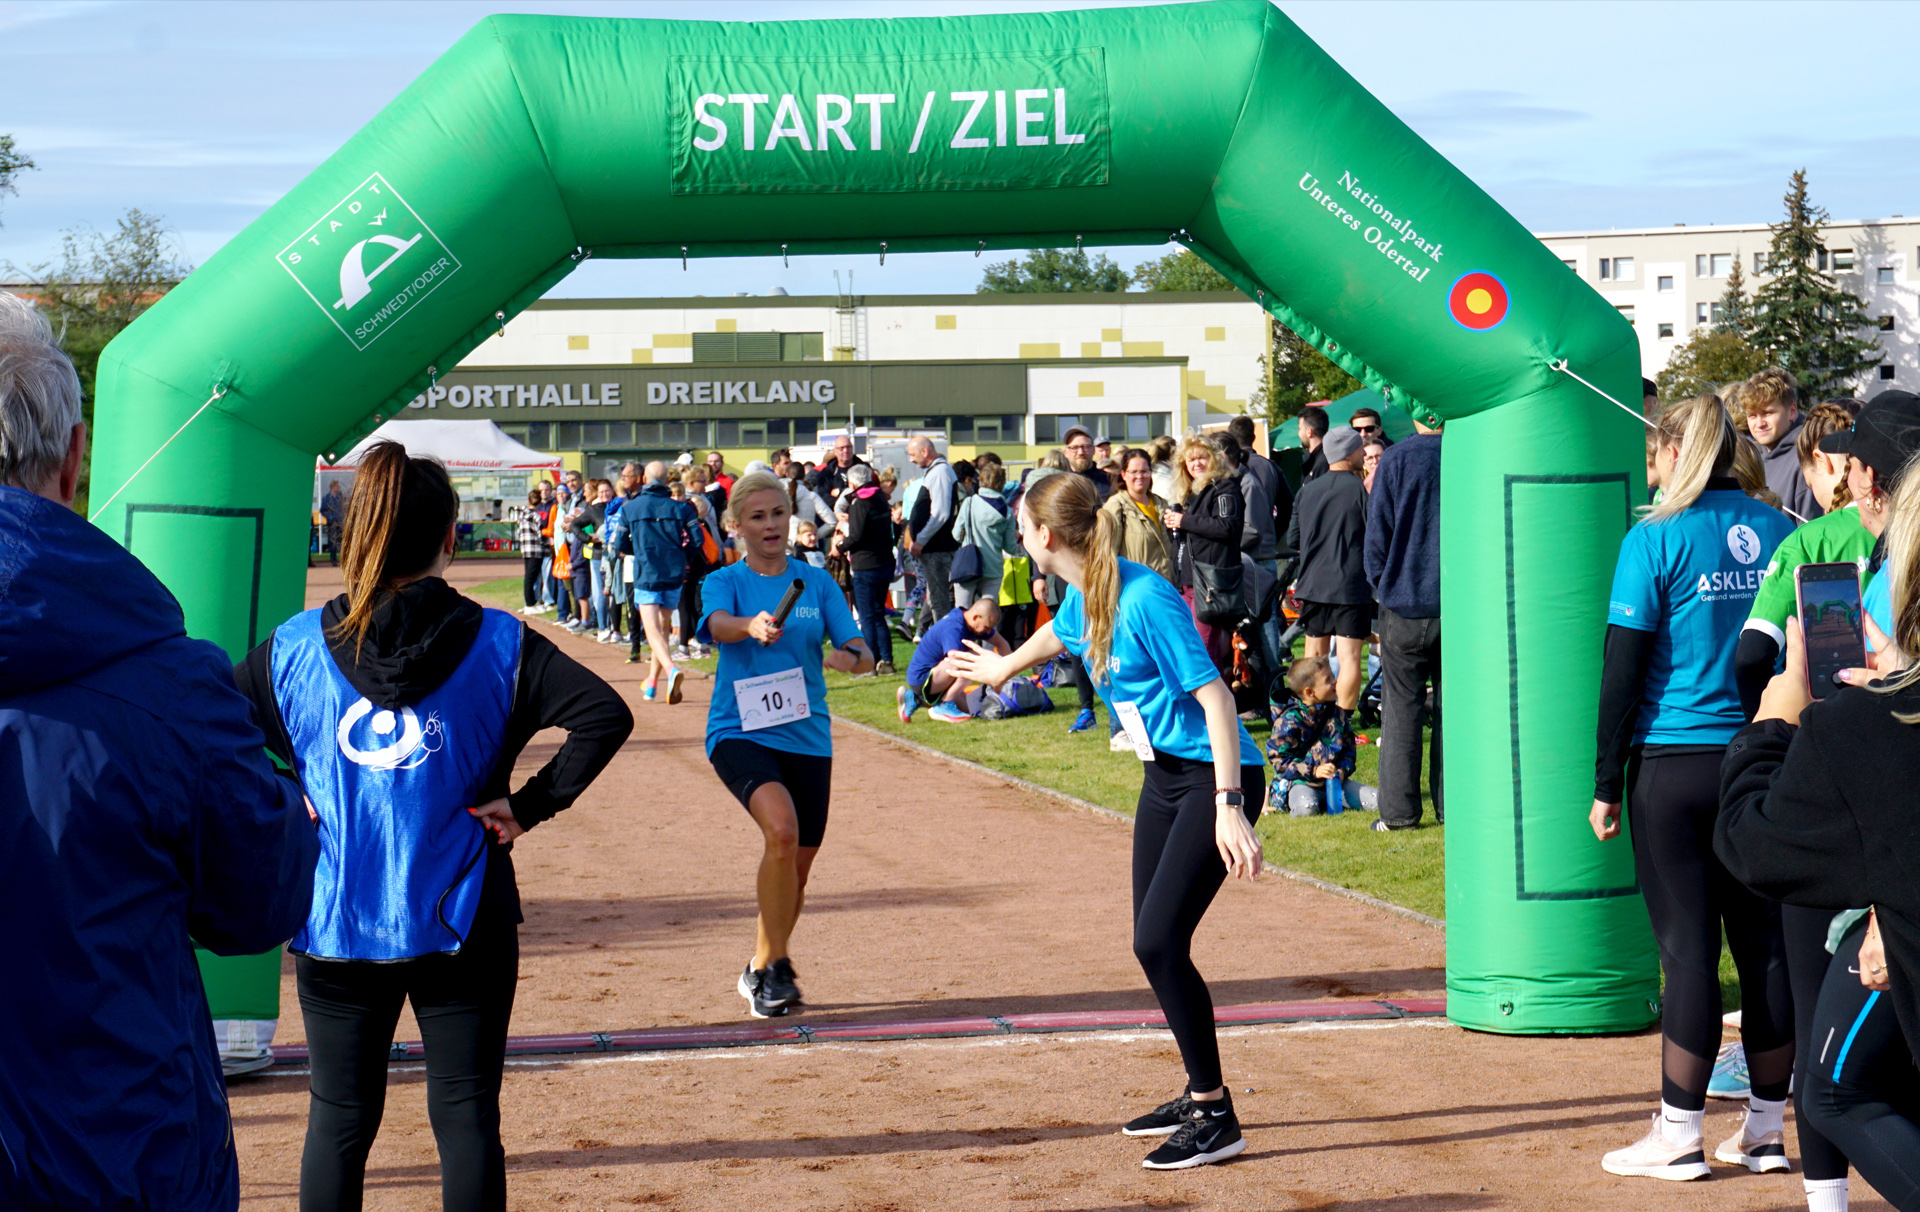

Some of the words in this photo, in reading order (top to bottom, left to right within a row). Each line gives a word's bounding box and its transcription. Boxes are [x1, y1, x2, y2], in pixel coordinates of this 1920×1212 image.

[692, 93, 896, 152] START
[908, 91, 936, 154] /
[950, 88, 1086, 149] ZIEL
[288, 183, 381, 265] STADT
[1298, 172, 1362, 231] Unteres
[1363, 226, 1431, 283] Odertal
[1337, 170, 1444, 263] Nationalpark
[354, 257, 451, 339] SCHWEDT/ODER
[647, 380, 837, 405] DREIKLANG
[447, 460, 503, 468] Schwedt/Oder
[1701, 593, 1728, 602] Gesund
[761, 691, 784, 712] 10
[786, 697, 793, 707] 1
